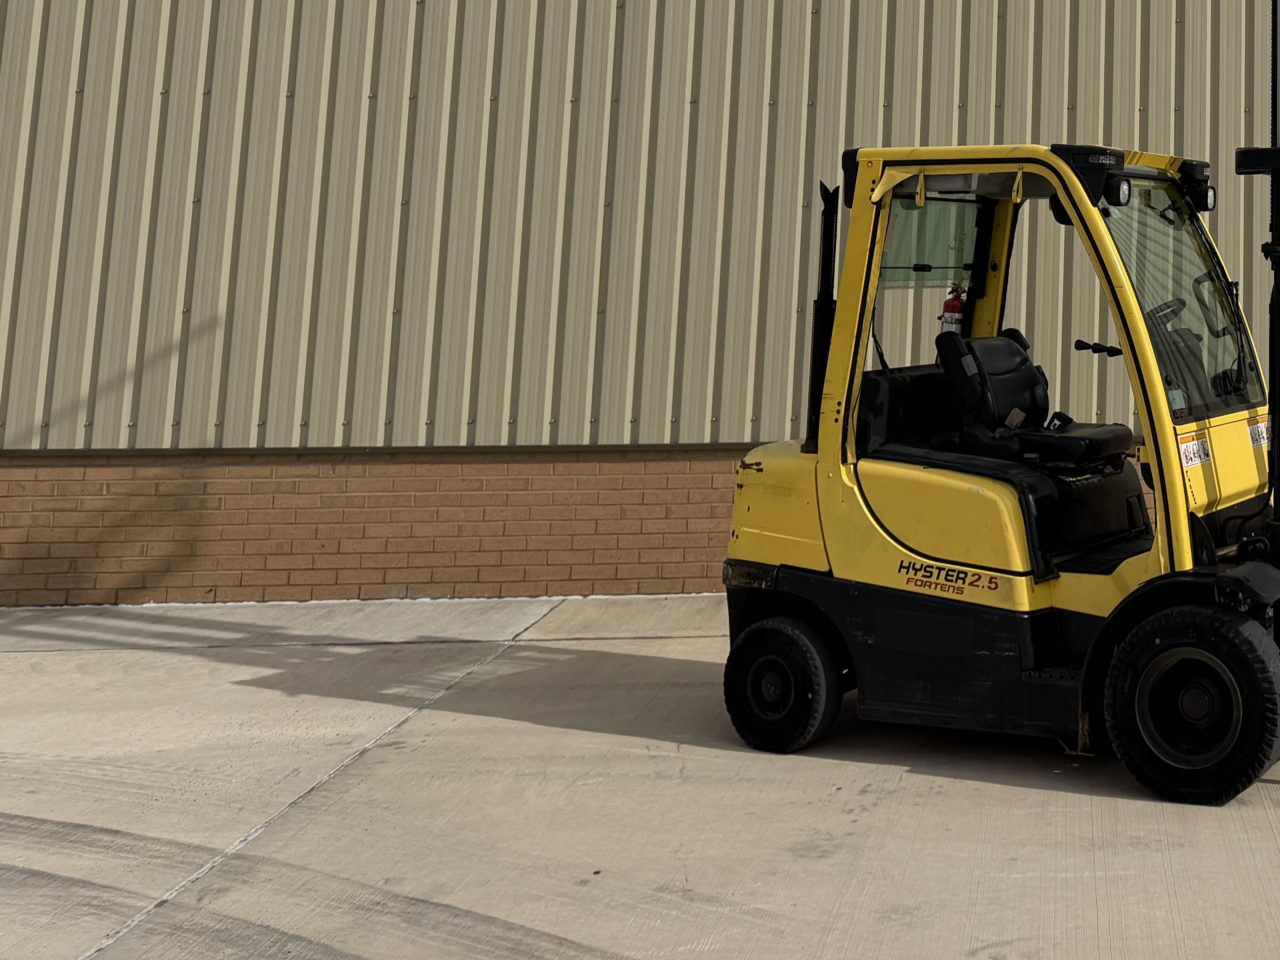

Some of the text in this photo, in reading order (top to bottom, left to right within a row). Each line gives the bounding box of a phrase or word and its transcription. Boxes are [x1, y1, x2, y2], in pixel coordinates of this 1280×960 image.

[897, 560, 999, 591] HYSTER 2.5
[906, 577, 965, 595] FORTENS
